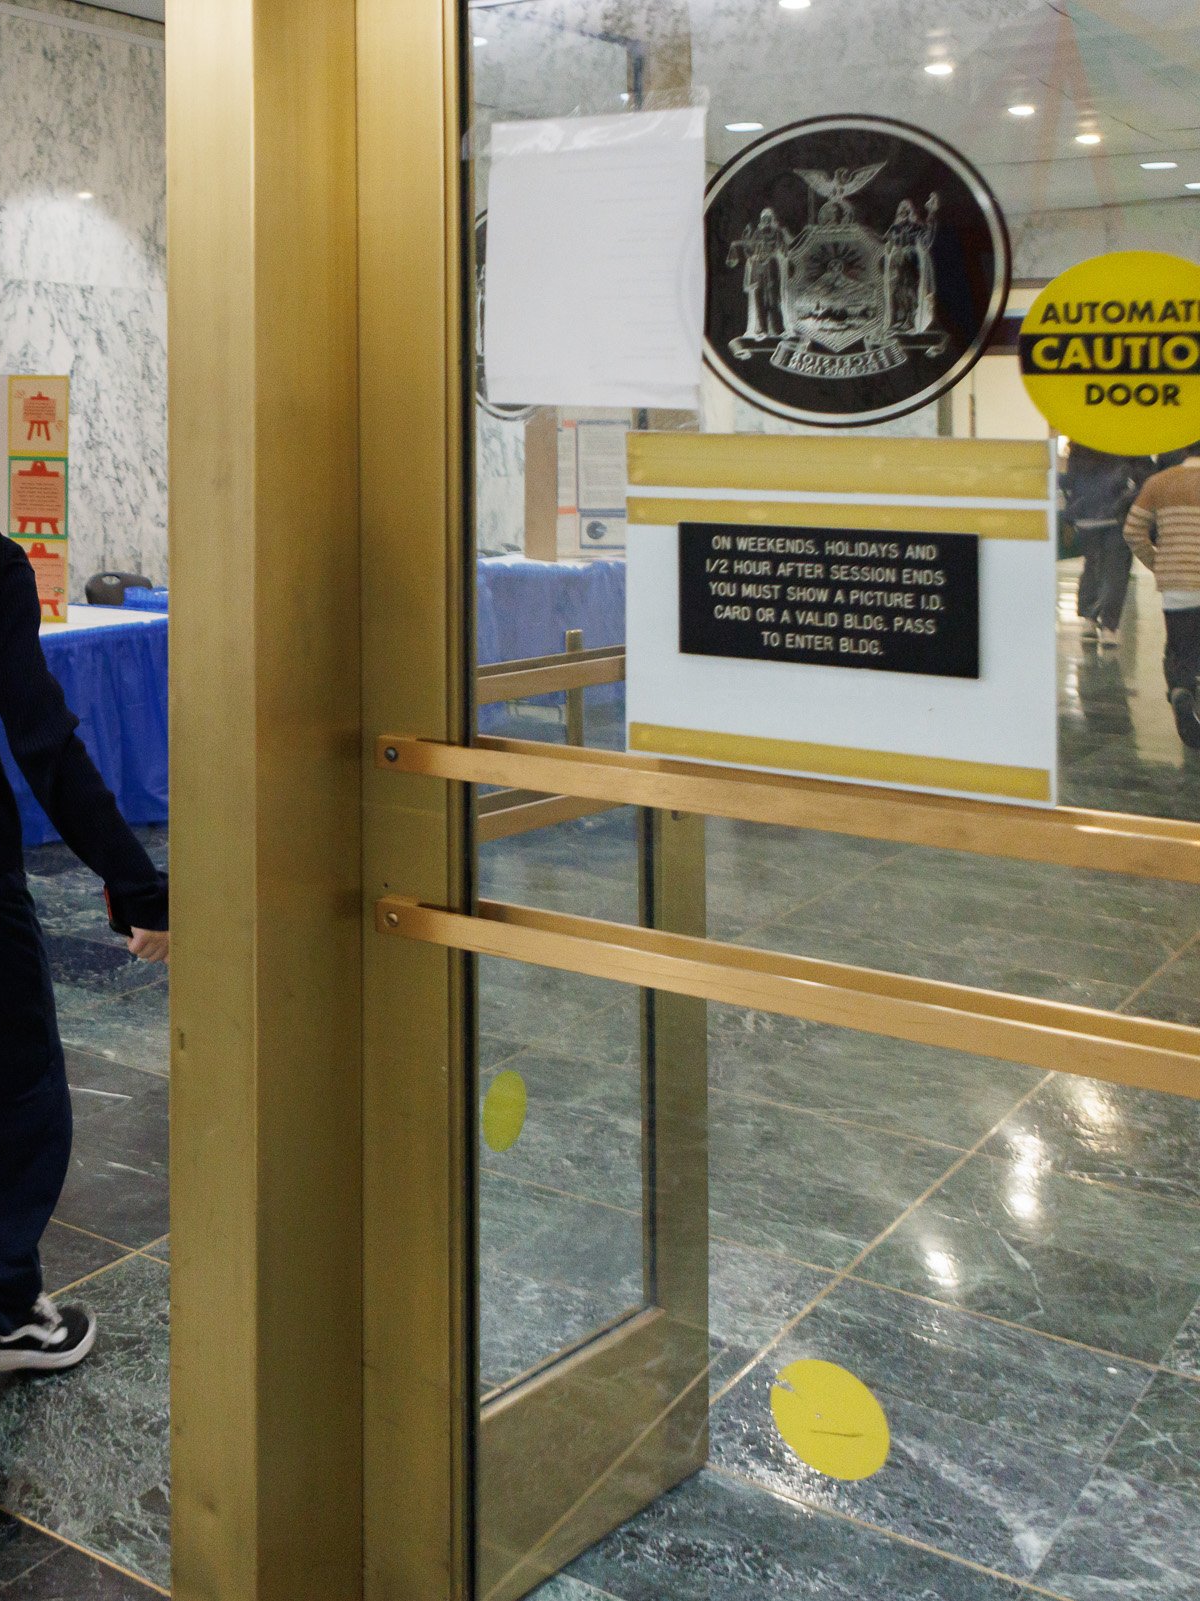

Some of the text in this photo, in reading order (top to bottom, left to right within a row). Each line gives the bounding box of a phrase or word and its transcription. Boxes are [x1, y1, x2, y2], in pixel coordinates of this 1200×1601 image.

[1085, 383, 1181, 407] DOOR
[712, 535, 731, 550] ON
[825, 541, 898, 558] HOLIDAYS
[905, 544, 937, 561] AND
[734, 560, 772, 576] HOUR
[776, 562, 824, 579] AFTER
[830, 566, 896, 583] SESSION
[902, 568, 945, 584] ENDS
[709, 582, 945, 610] YOU MUST SHOW A PICTURE I.D.
[714, 605, 936, 634] CARD OR A VALID BLDG. PASS
[762, 631, 884, 655] TO ENTER BLDG.
